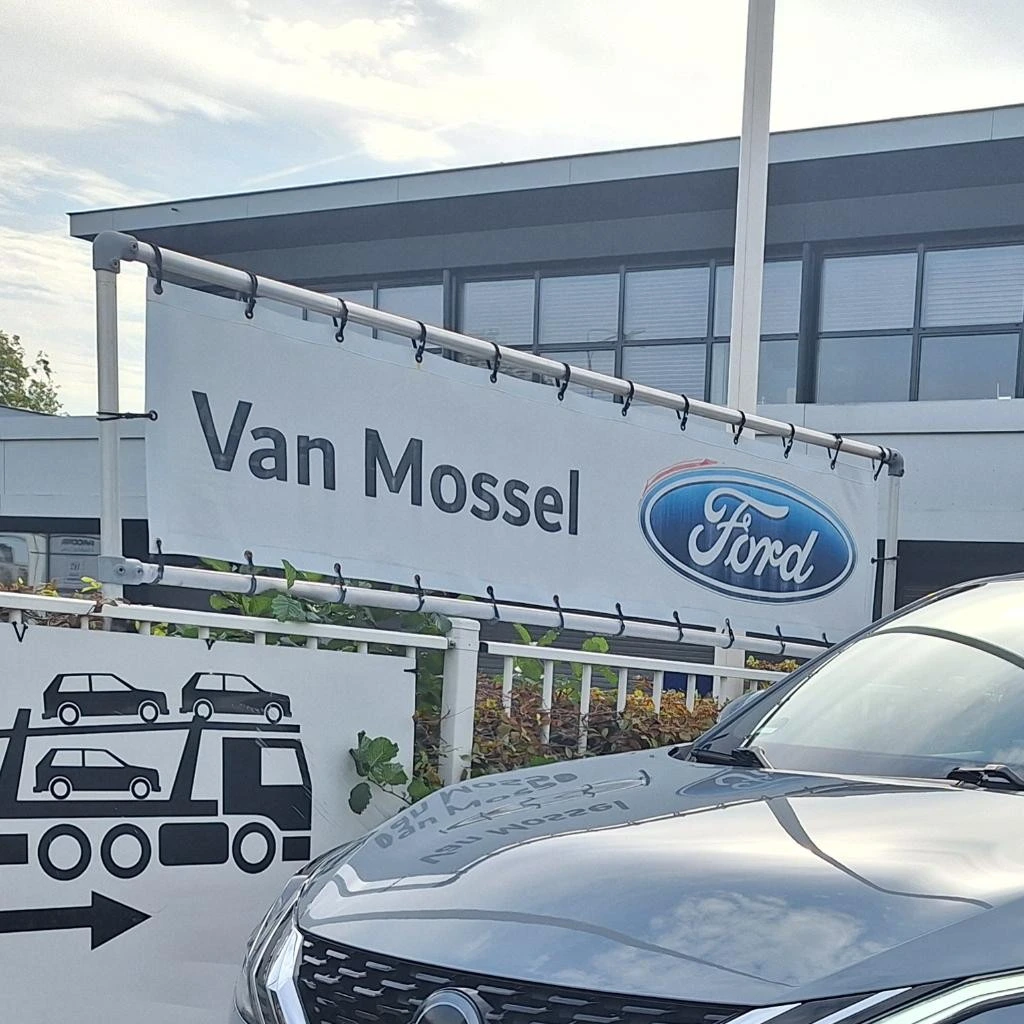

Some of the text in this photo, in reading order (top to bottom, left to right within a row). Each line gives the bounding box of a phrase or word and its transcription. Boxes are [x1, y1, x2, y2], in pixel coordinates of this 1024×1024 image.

[191, 390, 580, 536] Van Mossel
[687, 487, 820, 585] Ford
